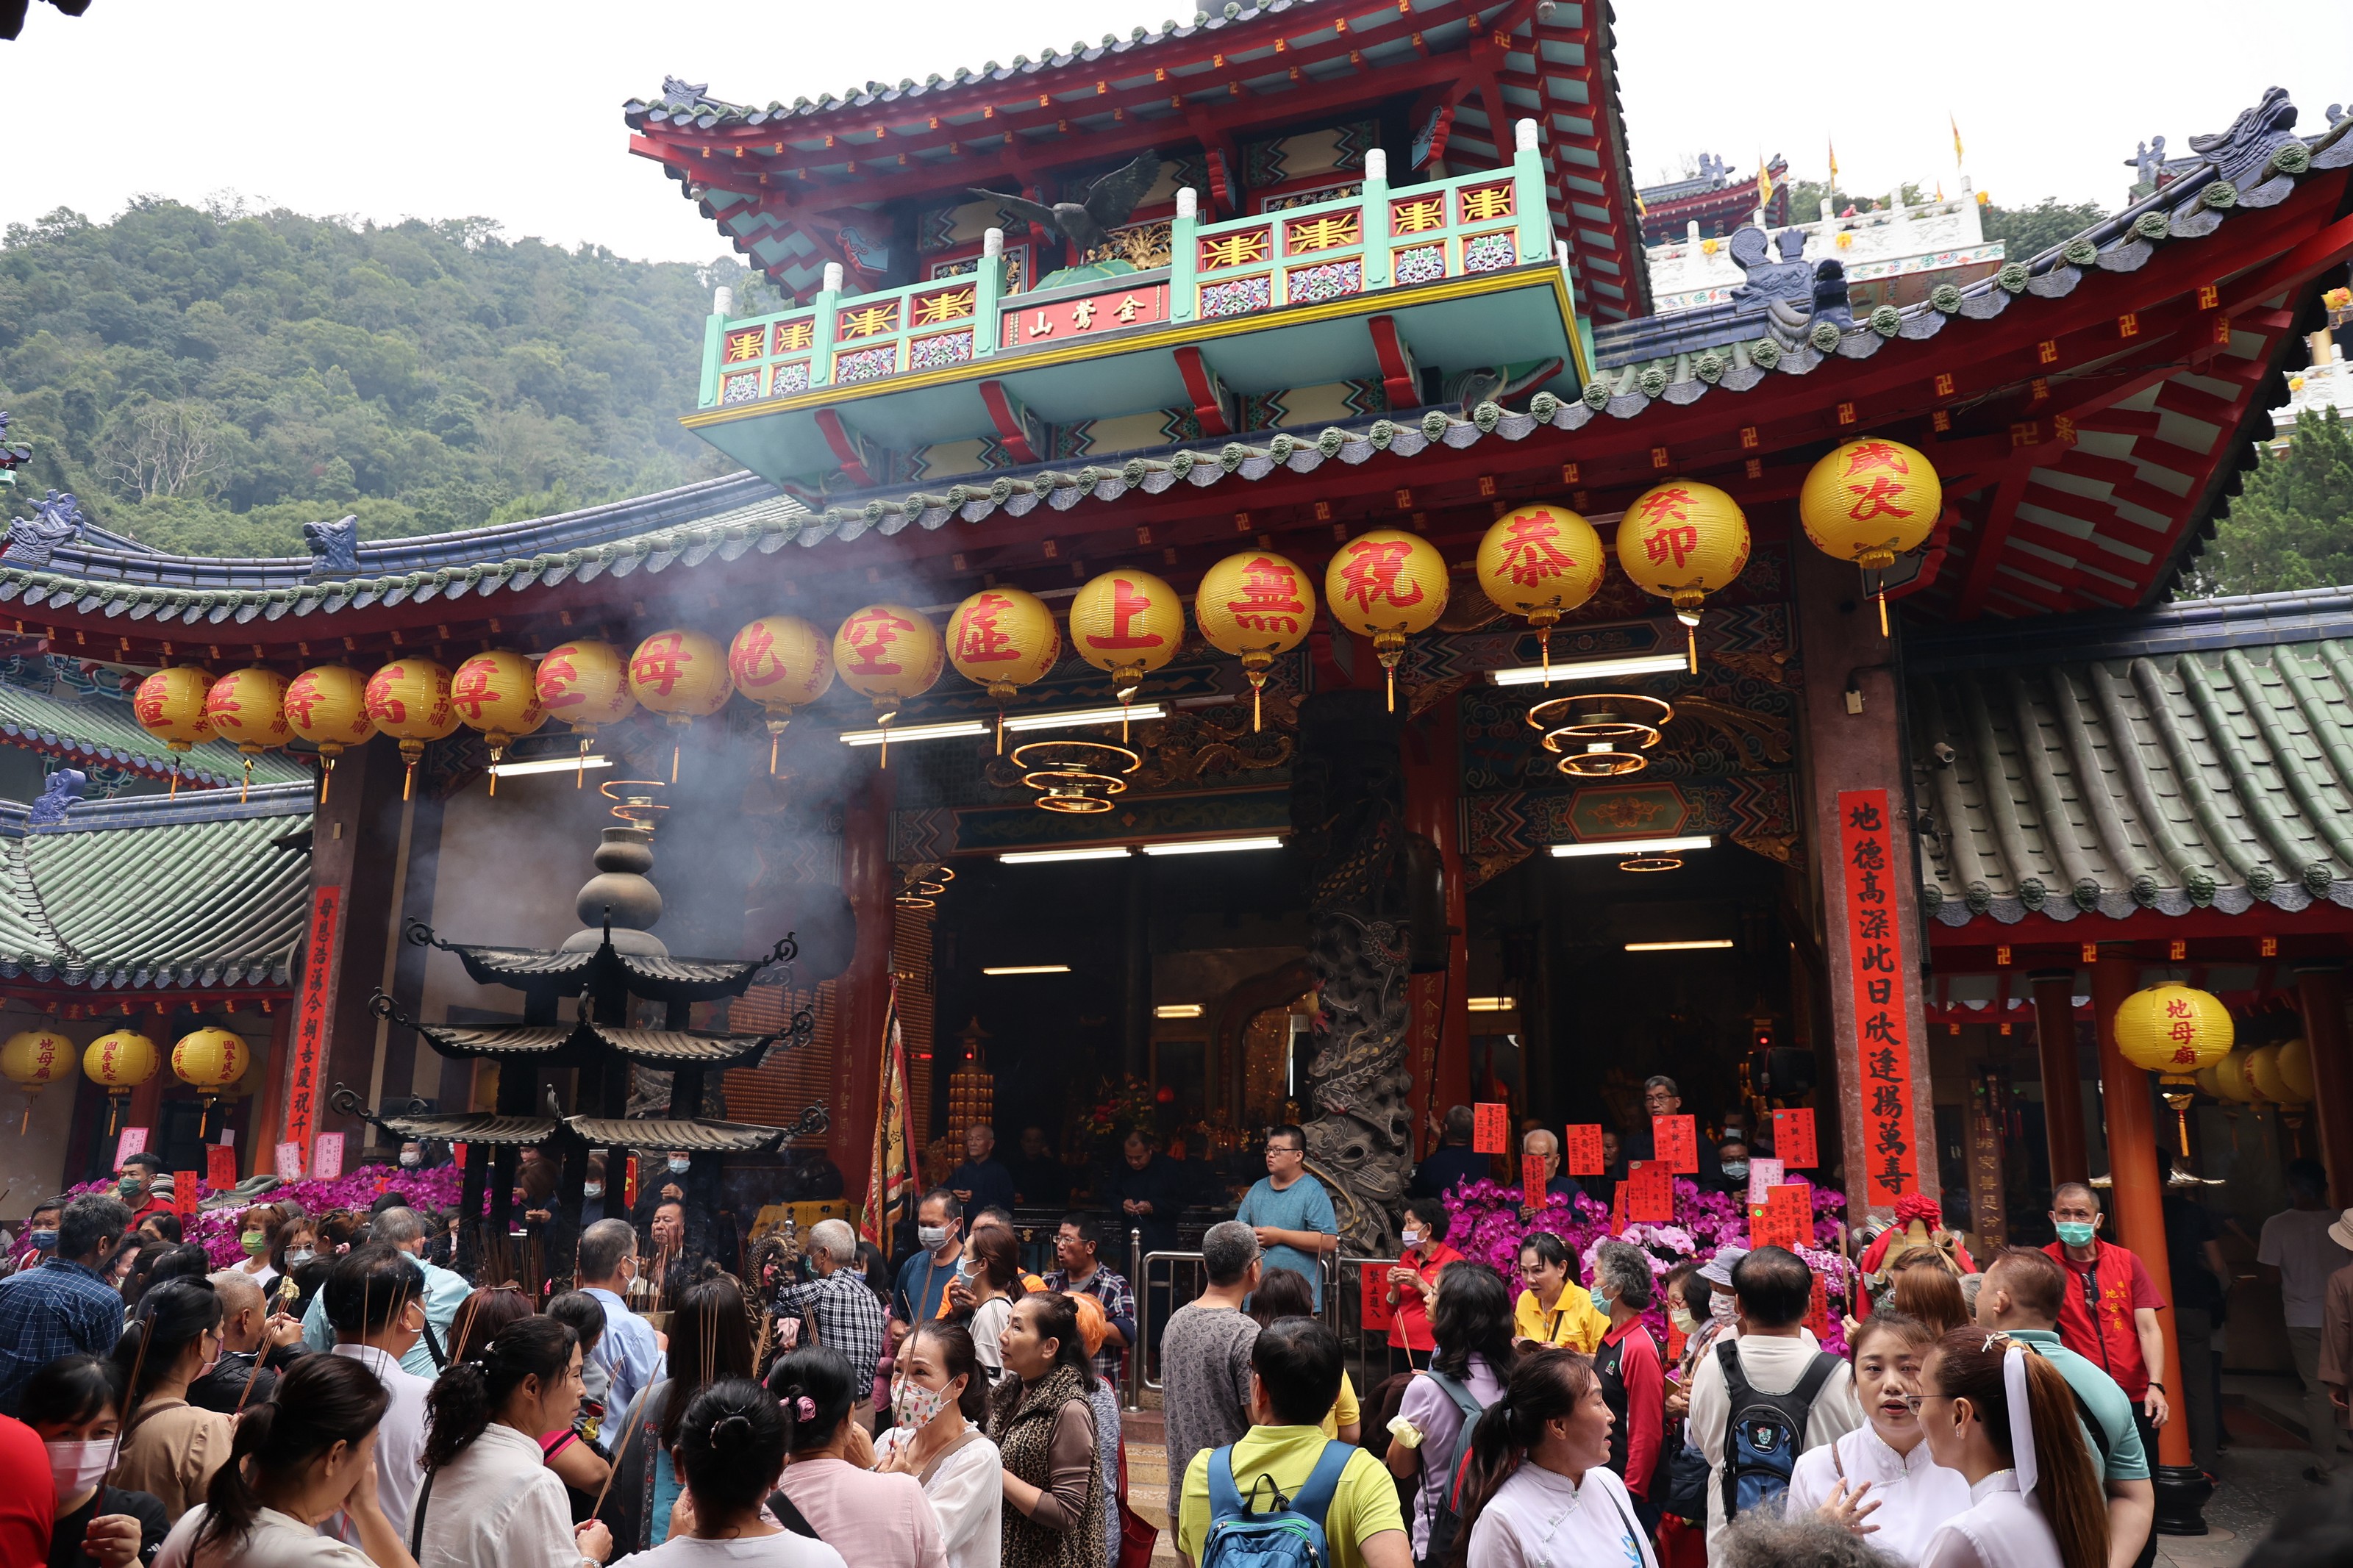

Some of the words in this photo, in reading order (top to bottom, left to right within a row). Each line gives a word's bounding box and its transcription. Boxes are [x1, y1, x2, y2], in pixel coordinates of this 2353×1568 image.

[1843, 443, 1914, 521] 歲次
[1494, 510, 1578, 588] 恭
[1639, 488, 1699, 569] 癸卯
[1227, 557, 1305, 634] 無
[1340, 540, 1424, 615] 祝
[843, 609, 915, 676] 空
[1086, 579, 1165, 650] 上
[536, 647, 587, 709] 至
[631, 633, 693, 696] 母
[728, 622, 787, 689] 地
[426, 667, 451, 730] 風調雨順
[451, 659, 501, 720] 尊
[32, 1038, 56, 1080] 地母廟
[101, 1041, 118, 1081] 國泰民安
[218, 1040, 237, 1081] 國泰民安
[2165, 998, 2196, 1065] 地母廟
[1579, 1126, 1591, 1174] 聖壽無疆
[1671, 1119, 1683, 1168] 聖誕千秋
[1789, 1112, 1803, 1163] 聖誕千秋
[1370, 1270, 1381, 1318] 禁止進入
